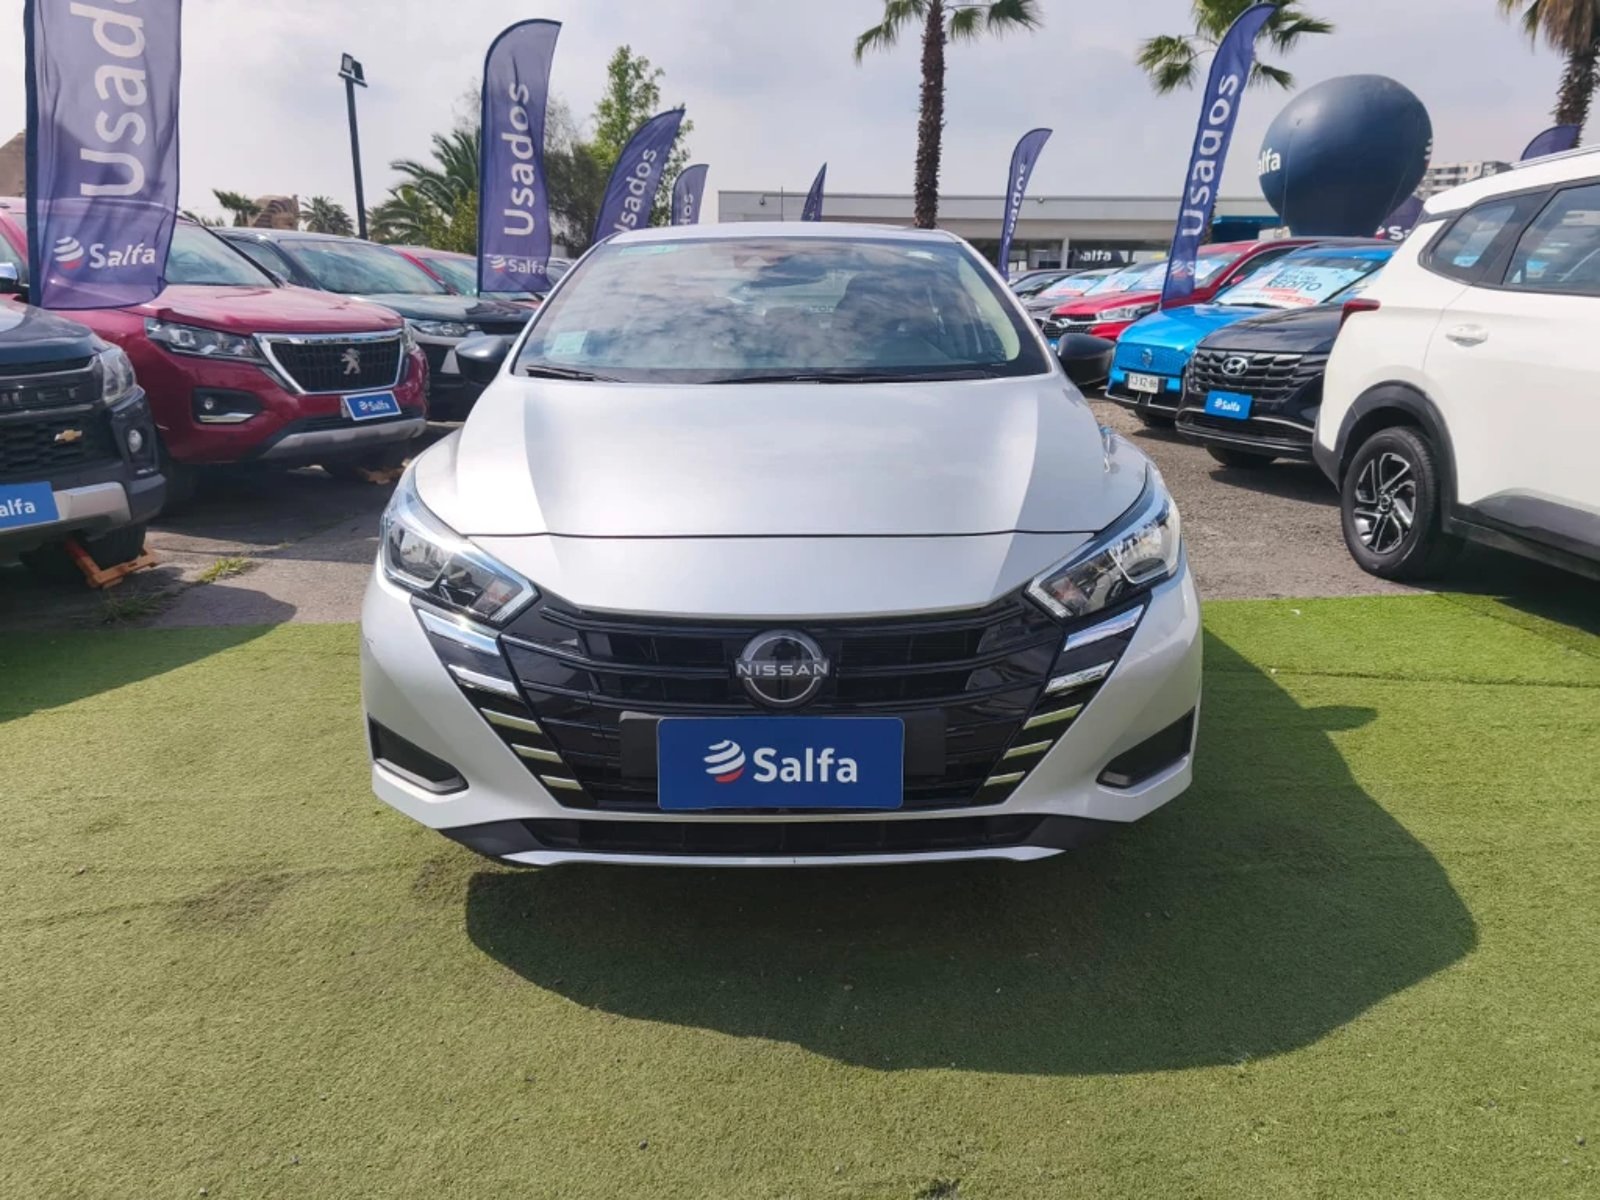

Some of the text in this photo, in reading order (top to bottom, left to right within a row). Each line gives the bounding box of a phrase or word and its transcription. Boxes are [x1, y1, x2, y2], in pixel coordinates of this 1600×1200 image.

[70, 0, 147, 197] Usad
[501, 82, 535, 236] Usados
[89, 242, 156, 269] Salfa
[508, 258, 546, 275] Salfa
[737, 661, 829, 677] NISSAN
[752, 747, 858, 783] Salfa
